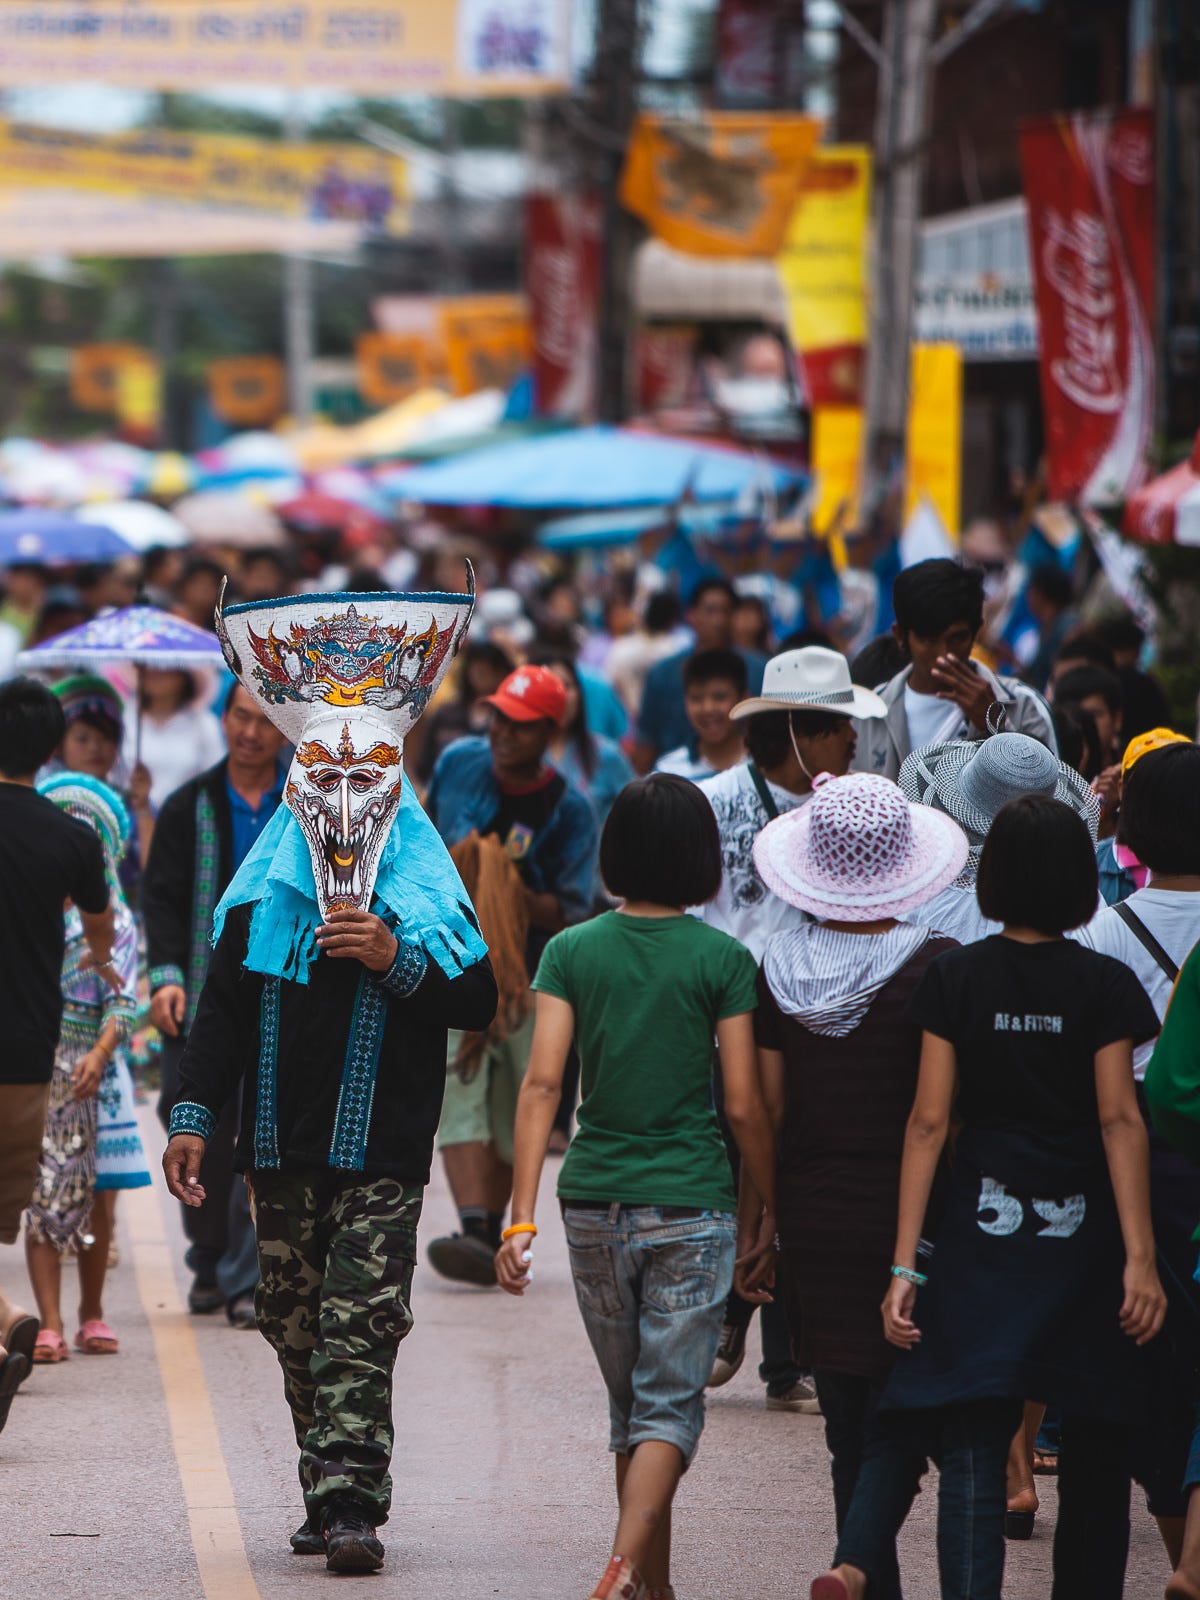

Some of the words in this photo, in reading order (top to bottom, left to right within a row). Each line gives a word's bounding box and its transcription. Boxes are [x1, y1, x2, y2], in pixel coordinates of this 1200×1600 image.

[1041, 207, 1125, 414] Coca-Cola
[1011, 1016, 1022, 1032] &
[1024, 1014, 1064, 1034] FITCH
